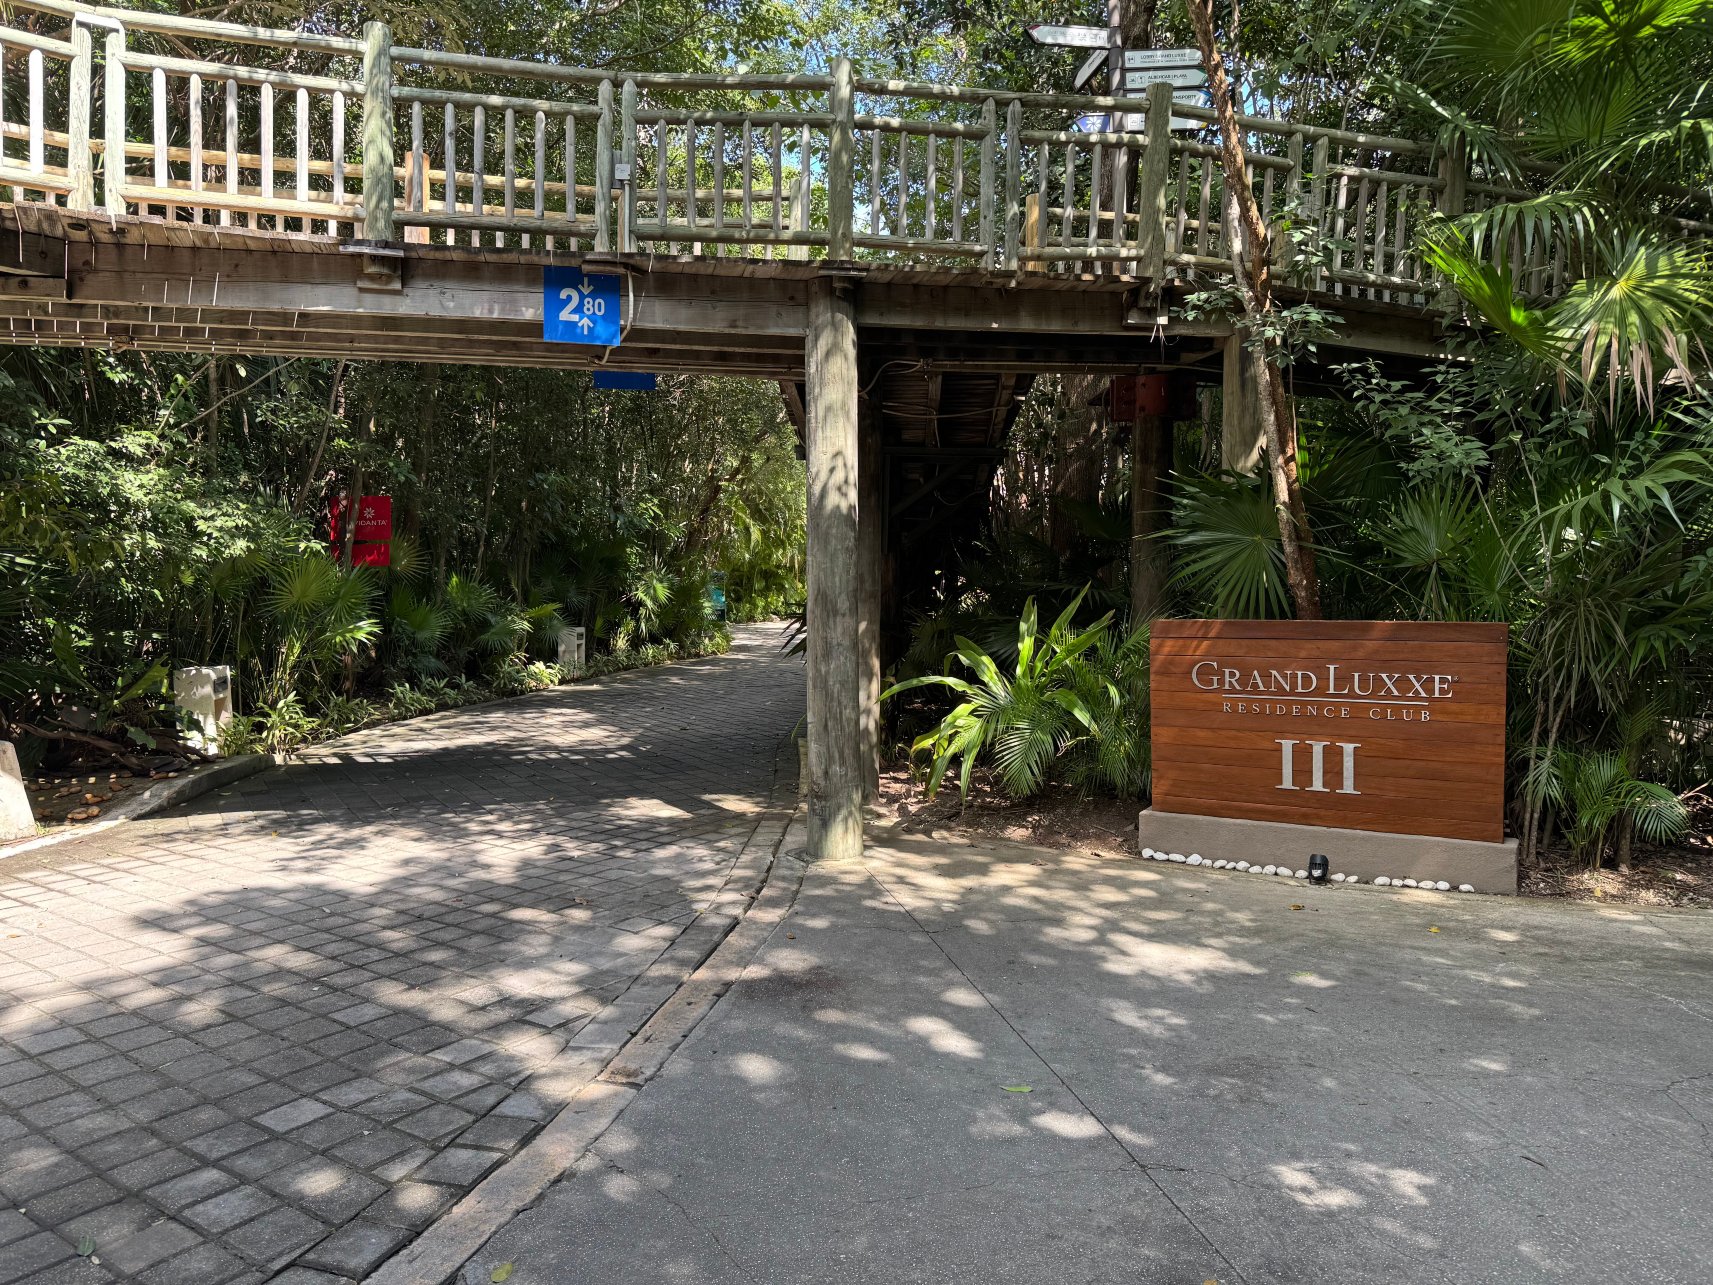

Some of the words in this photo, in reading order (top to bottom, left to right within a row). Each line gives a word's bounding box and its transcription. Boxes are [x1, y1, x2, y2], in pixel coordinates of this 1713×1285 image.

[1191, 661, 1318, 693] GRAND
[1325, 664, 1453, 698] LUXXE
[1222, 702, 1350, 718] RESIDENCE
[1369, 708, 1430, 722] CLUB
[1274, 739, 1362, 795] III
